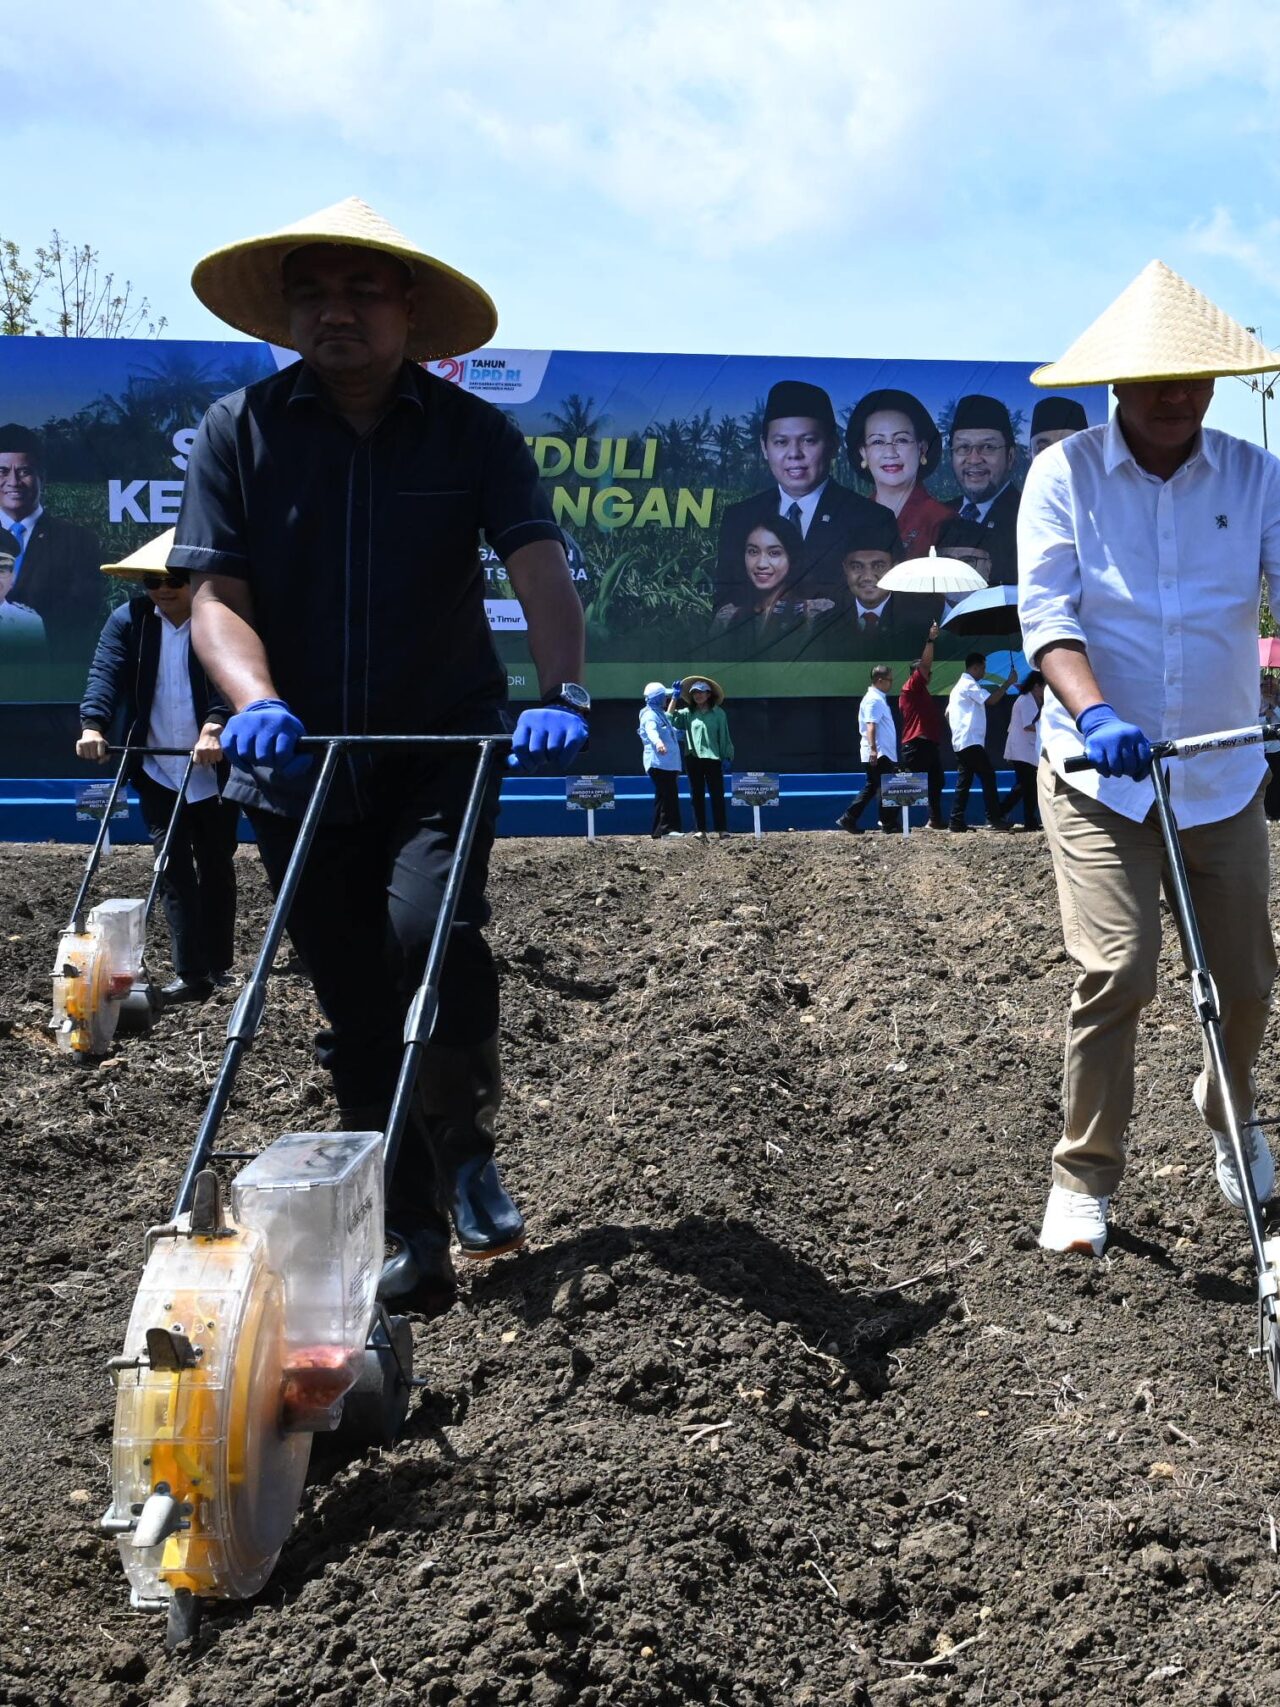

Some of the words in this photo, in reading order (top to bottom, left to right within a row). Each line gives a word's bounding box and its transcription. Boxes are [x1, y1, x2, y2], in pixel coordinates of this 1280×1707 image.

[471, 359, 506, 369] TAHUN
[470, 369, 501, 380] DPD
[505, 369, 522, 381] RI
[524, 436, 658, 479] DULI
[552, 486, 714, 529] NGAN
[507, 675, 526, 686] DRI
